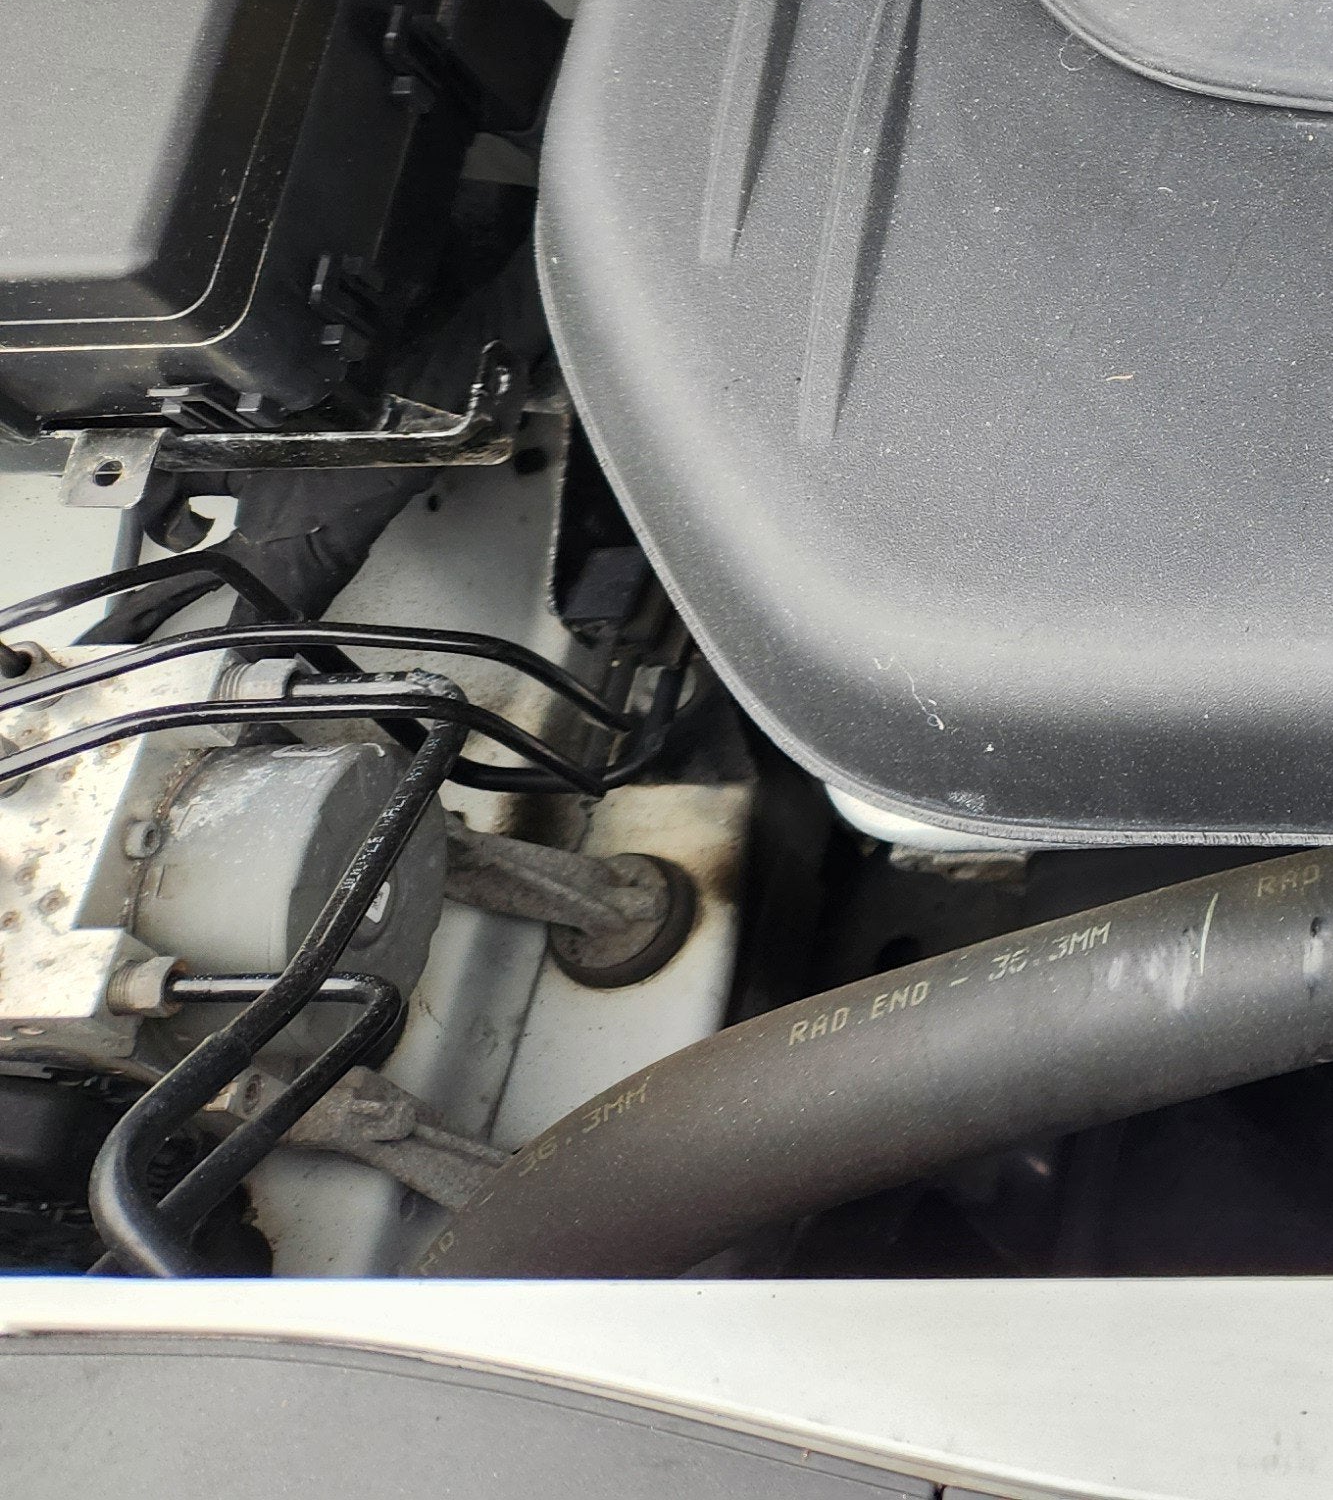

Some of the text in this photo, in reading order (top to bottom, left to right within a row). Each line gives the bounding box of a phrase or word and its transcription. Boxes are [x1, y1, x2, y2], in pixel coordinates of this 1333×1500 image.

[1256, 864, 1321, 898] RAD
[788, 1007, 850, 1046] RAD
[870, 980, 929, 1020] END
[988, 921, 1112, 980] 36.3MM
